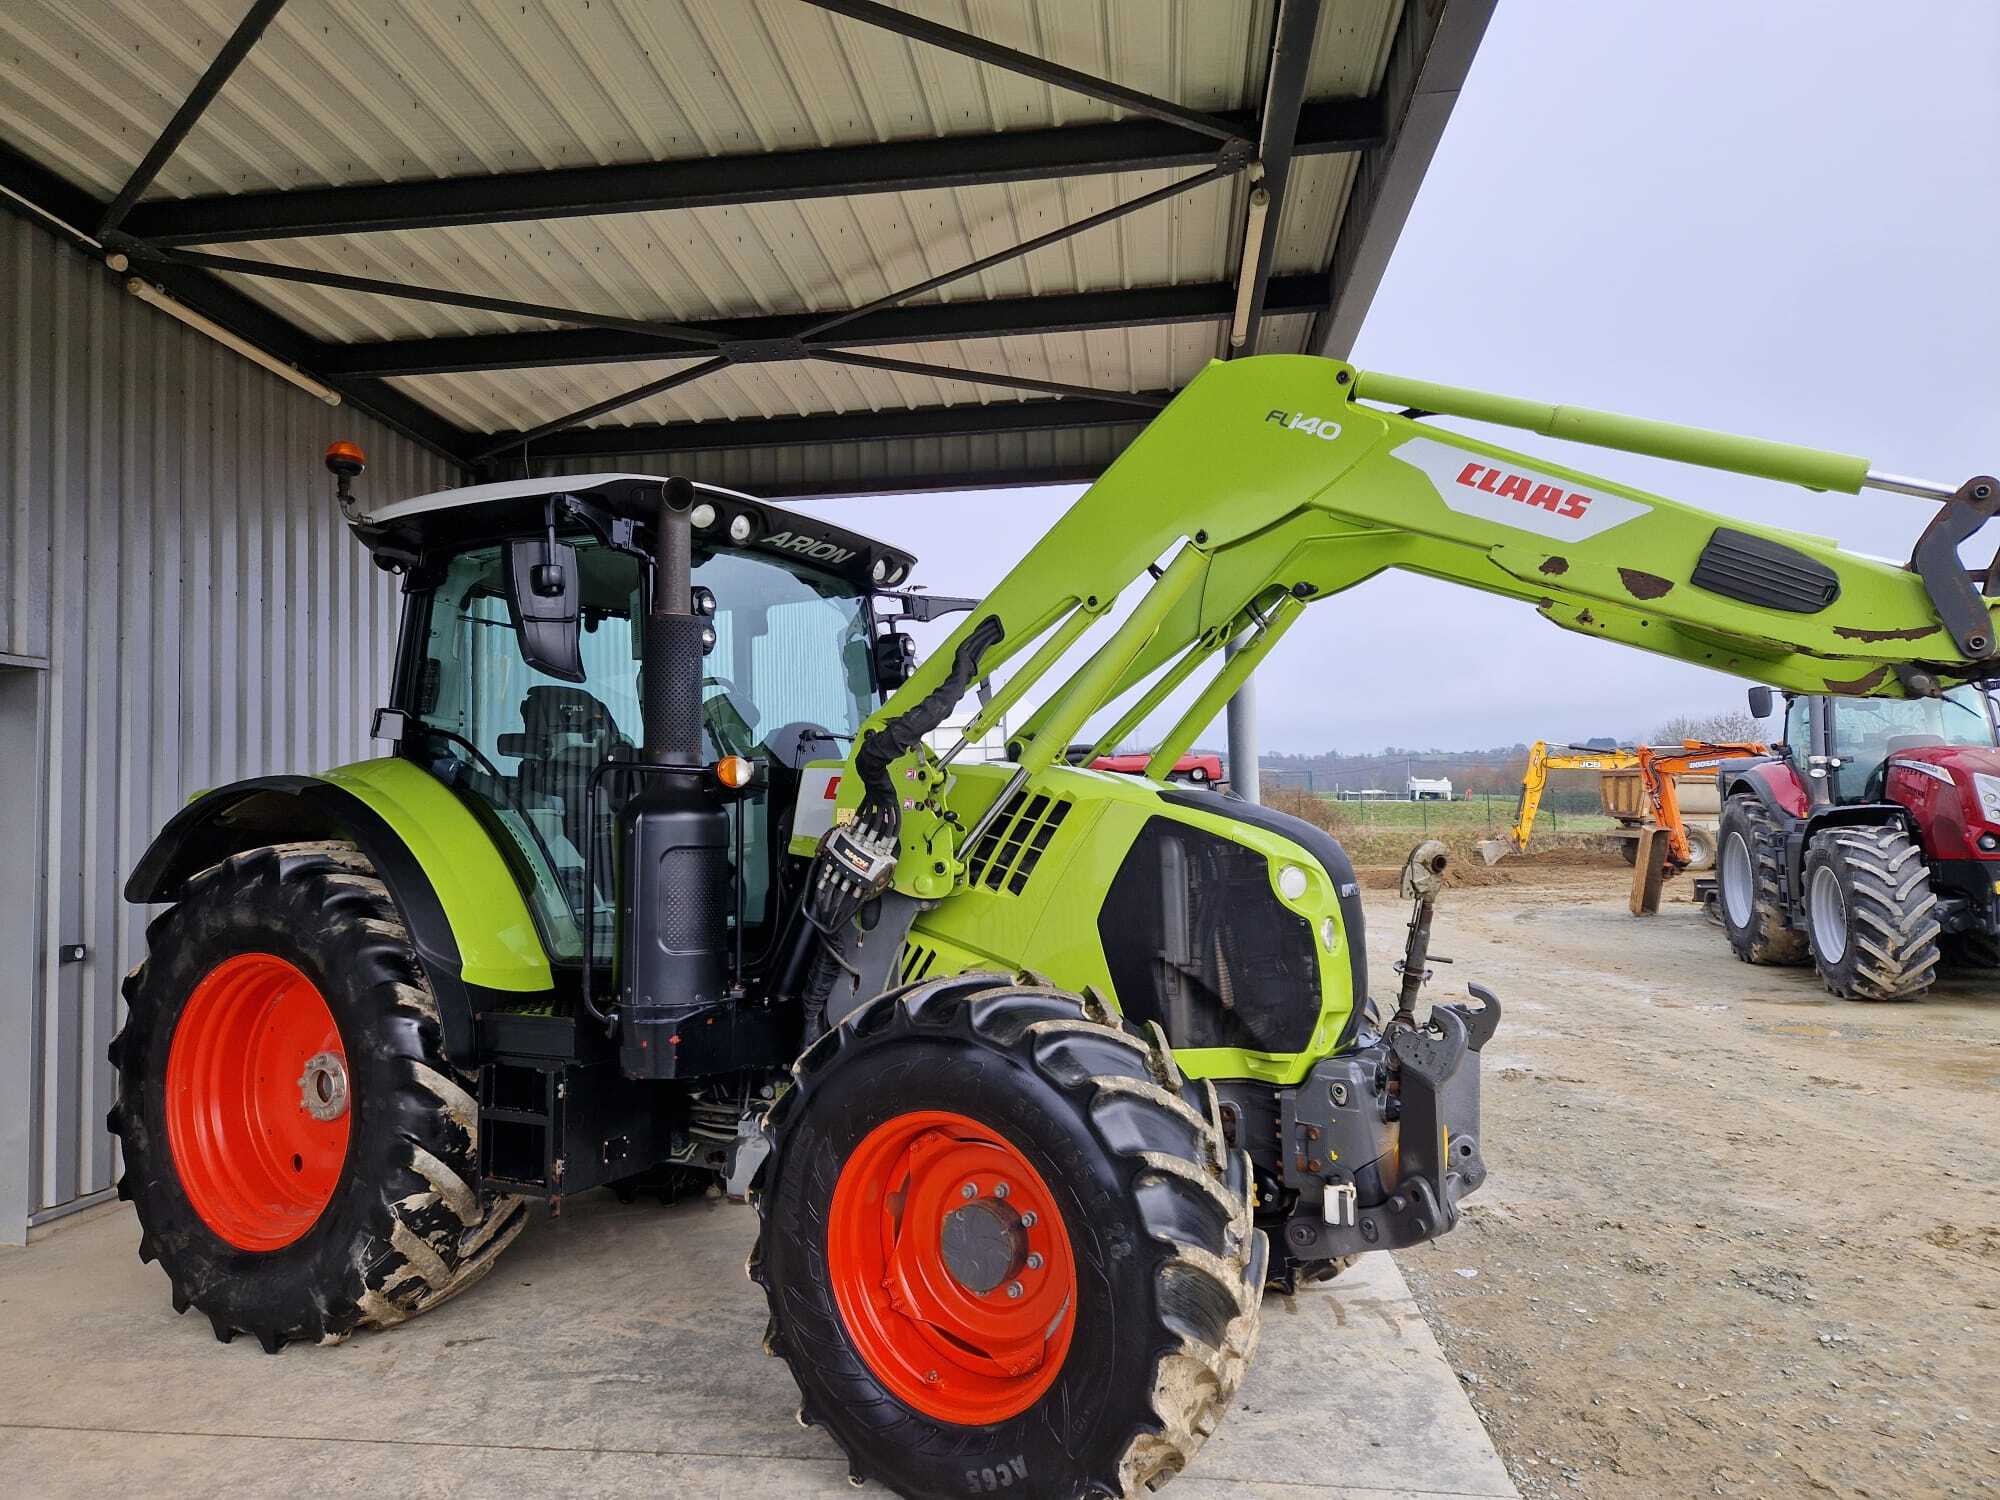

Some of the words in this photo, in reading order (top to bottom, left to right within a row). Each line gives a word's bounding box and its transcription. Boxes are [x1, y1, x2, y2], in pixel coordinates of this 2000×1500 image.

[1455, 462, 1593, 520] CLAAS
[760, 531, 856, 564] ARION
[965, 1454, 1030, 1494] AC65
